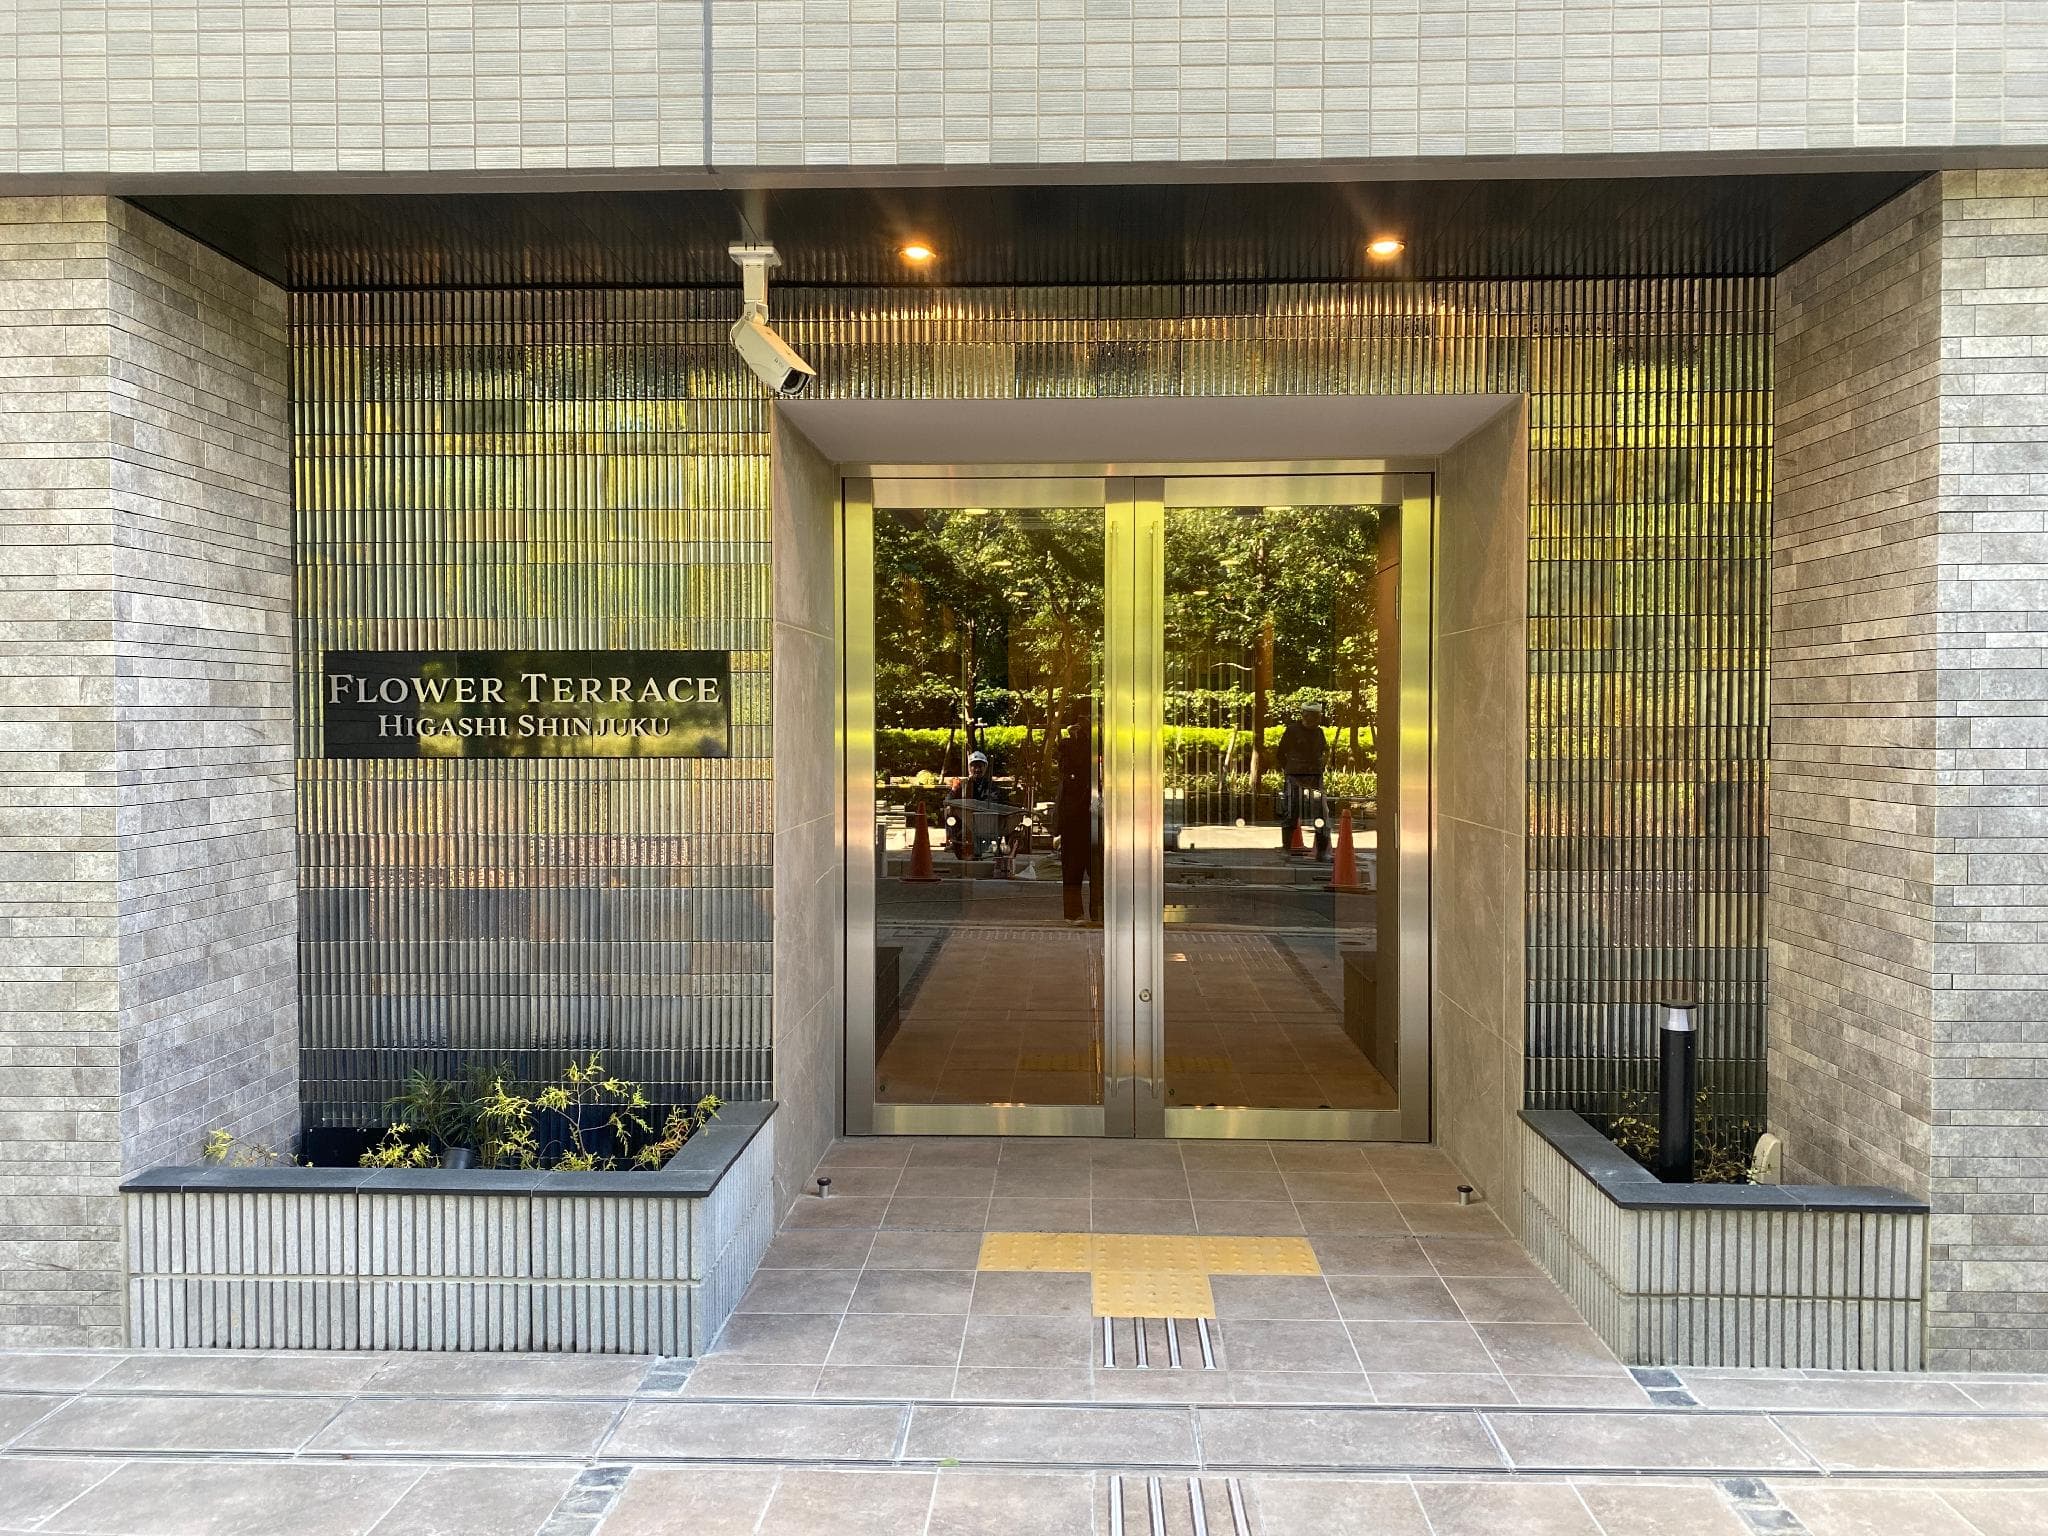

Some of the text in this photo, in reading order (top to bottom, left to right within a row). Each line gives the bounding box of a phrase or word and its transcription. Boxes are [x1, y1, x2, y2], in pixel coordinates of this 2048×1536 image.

[328, 672, 721, 704] FLOWER TERRACE
[378, 714, 671, 737] HIGASHI SHINJUKU
